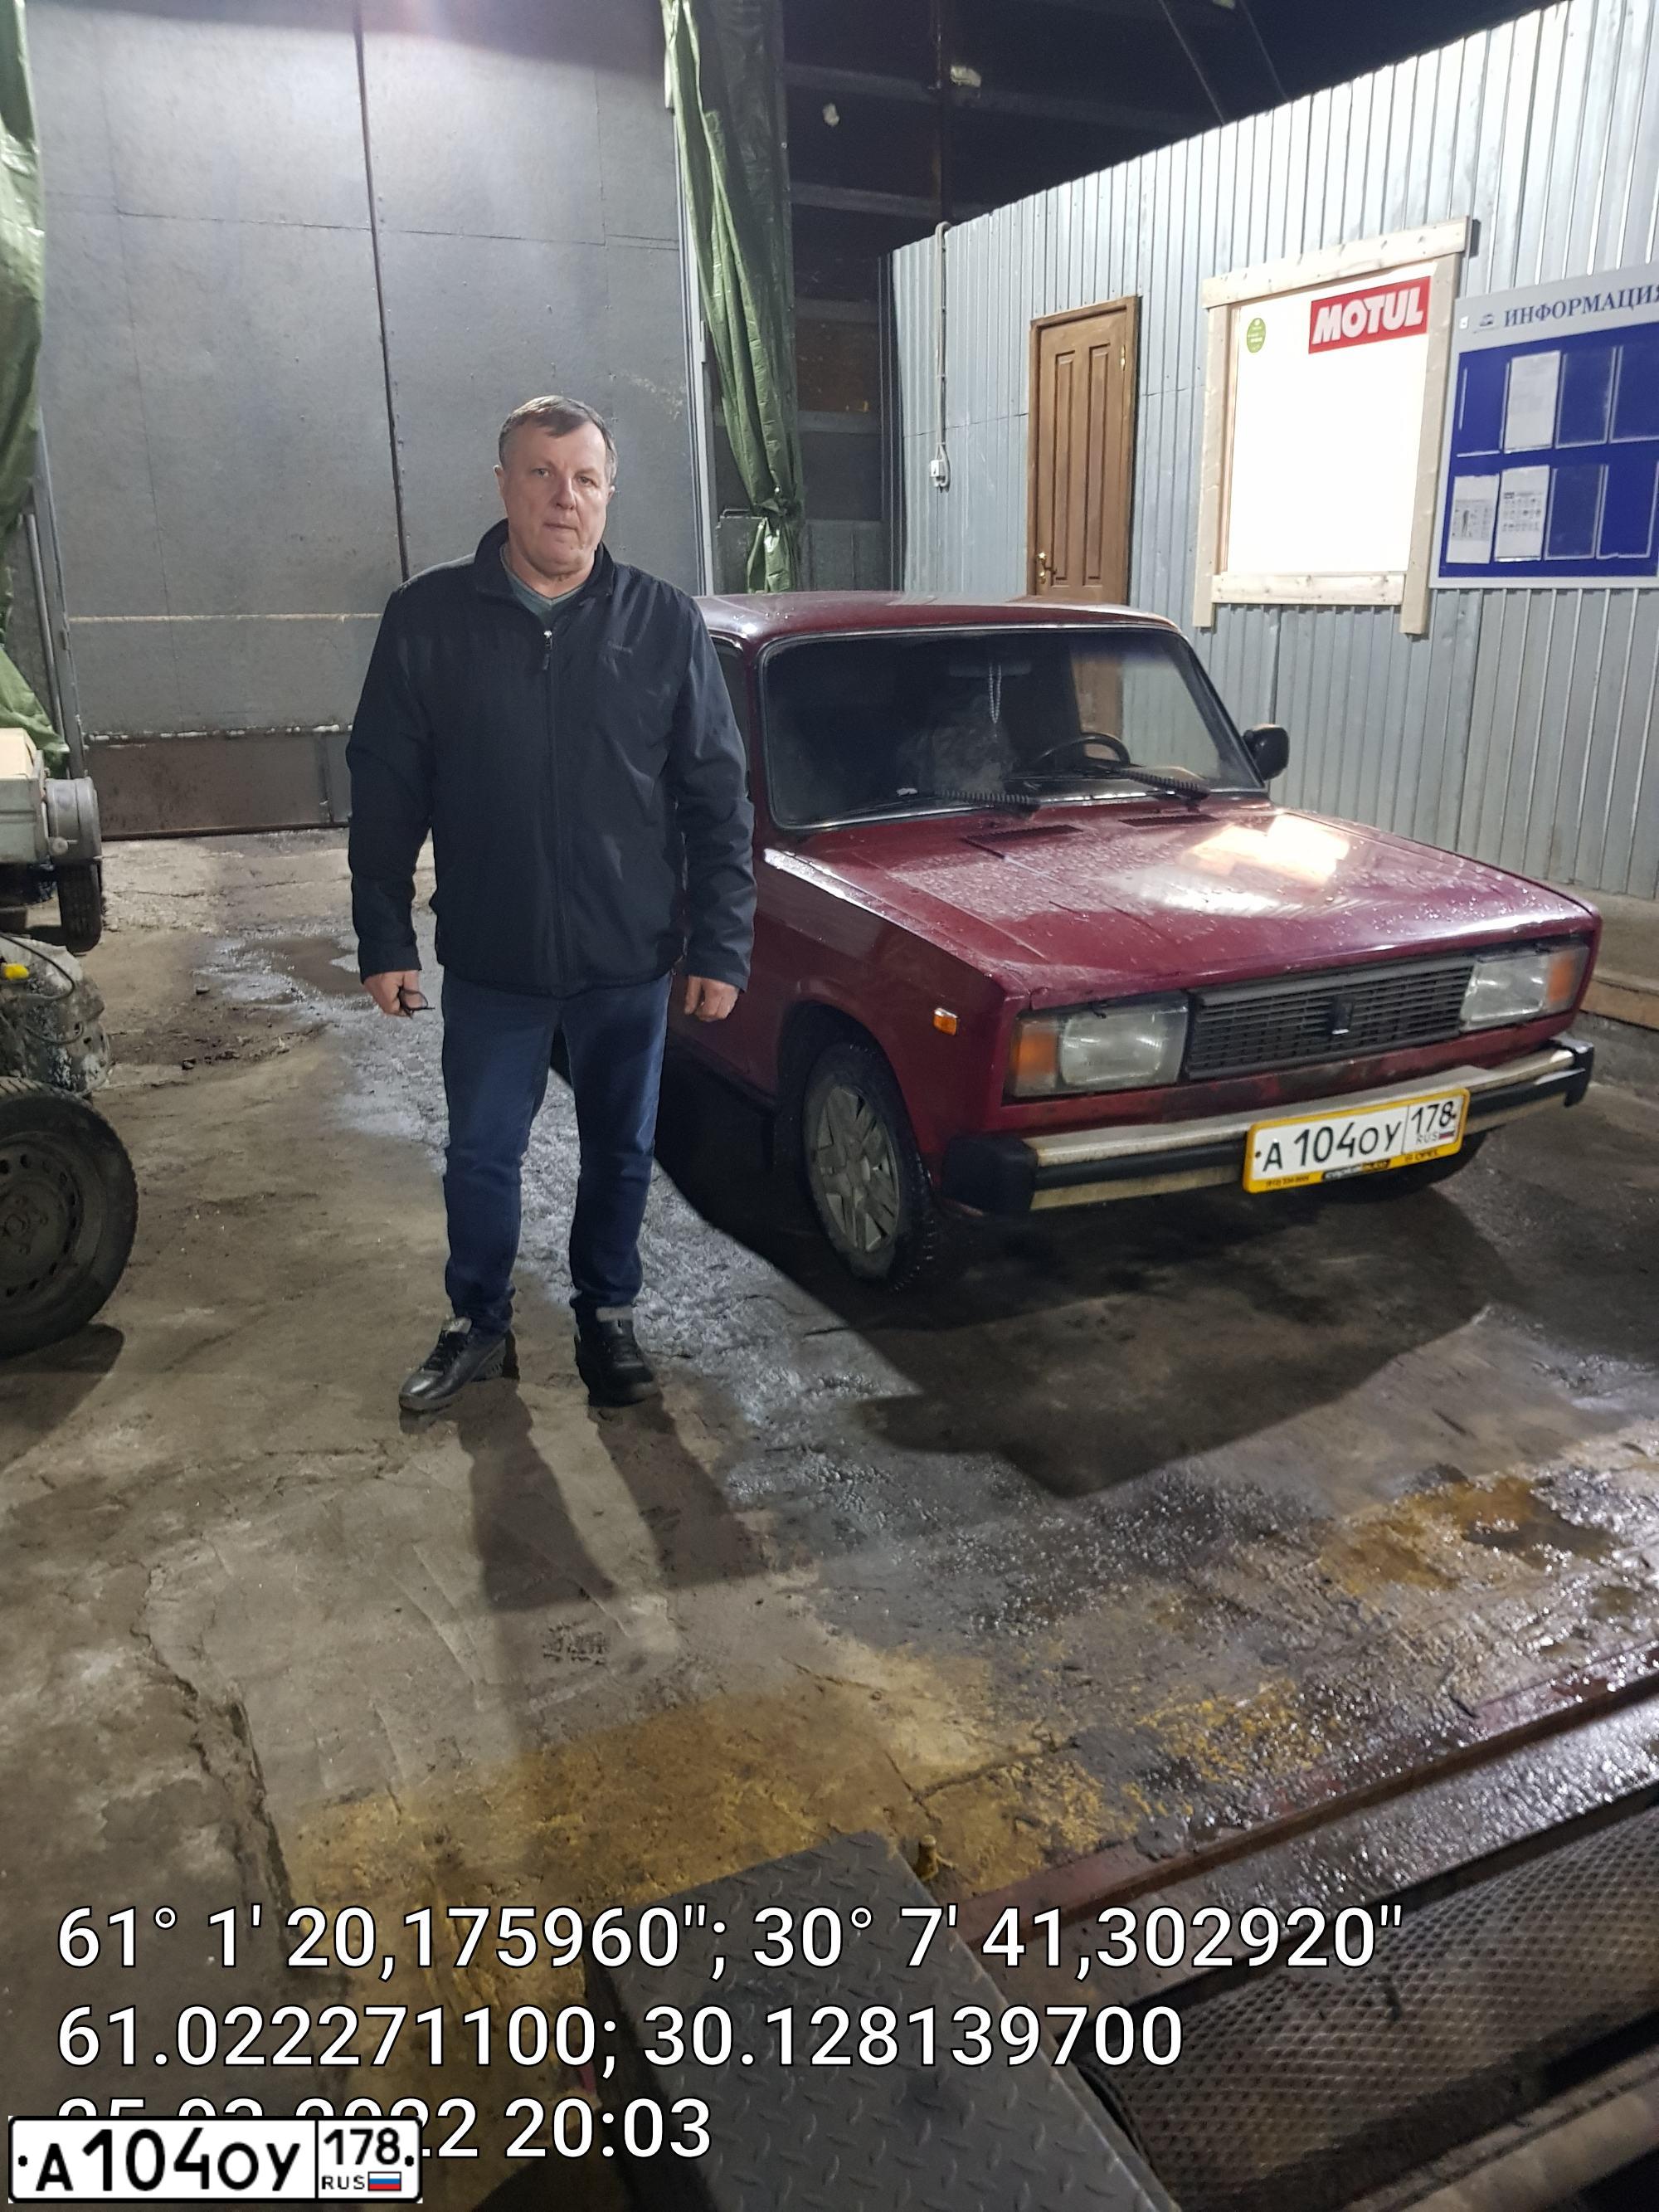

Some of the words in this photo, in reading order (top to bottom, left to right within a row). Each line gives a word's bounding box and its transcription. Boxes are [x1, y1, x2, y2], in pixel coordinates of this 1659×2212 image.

[1311, 286, 1424, 345] MOTUL
[1504, 284, 1659, 327] ИНФОРМАЦИ
[1410, 1100, 1454, 1134] 178
[1416, 1131, 1438, 1144] RUS
